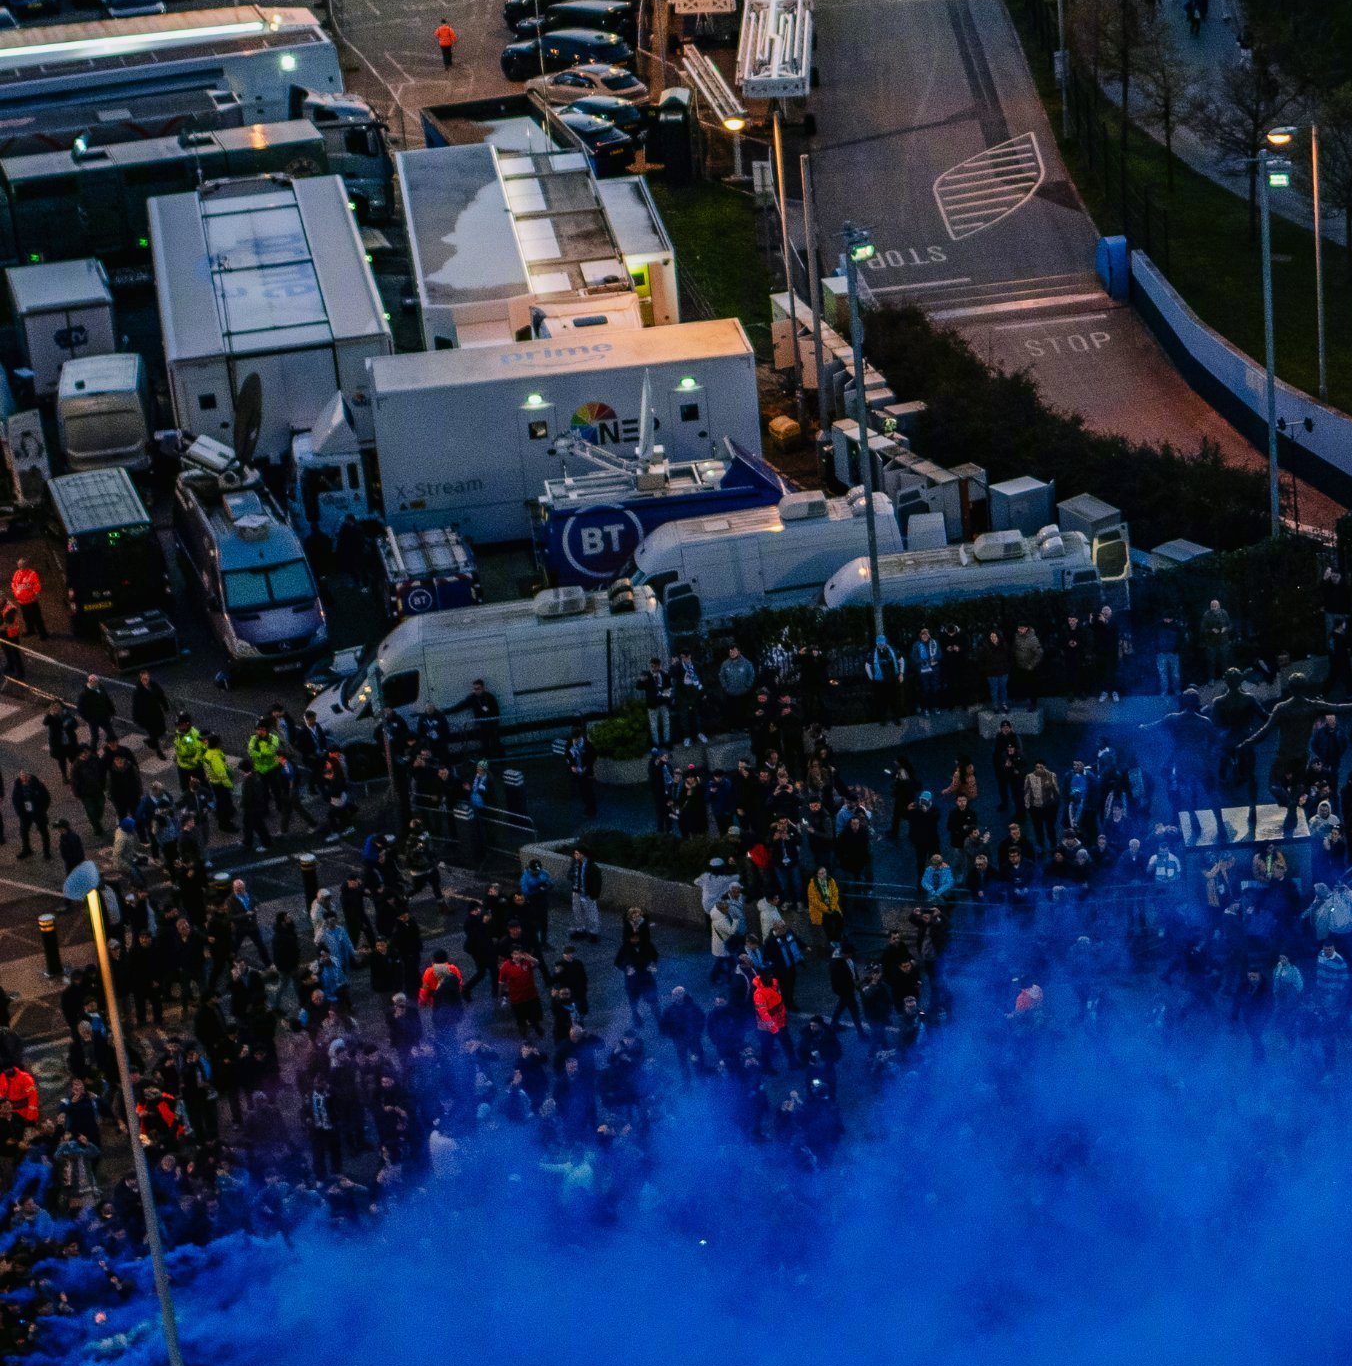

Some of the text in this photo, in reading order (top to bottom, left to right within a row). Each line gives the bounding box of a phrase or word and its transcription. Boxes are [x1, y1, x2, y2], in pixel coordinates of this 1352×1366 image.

[500, 341, 613, 367] prime
[1024, 332, 1111, 357] STOP
[581, 523, 625, 556] BT
